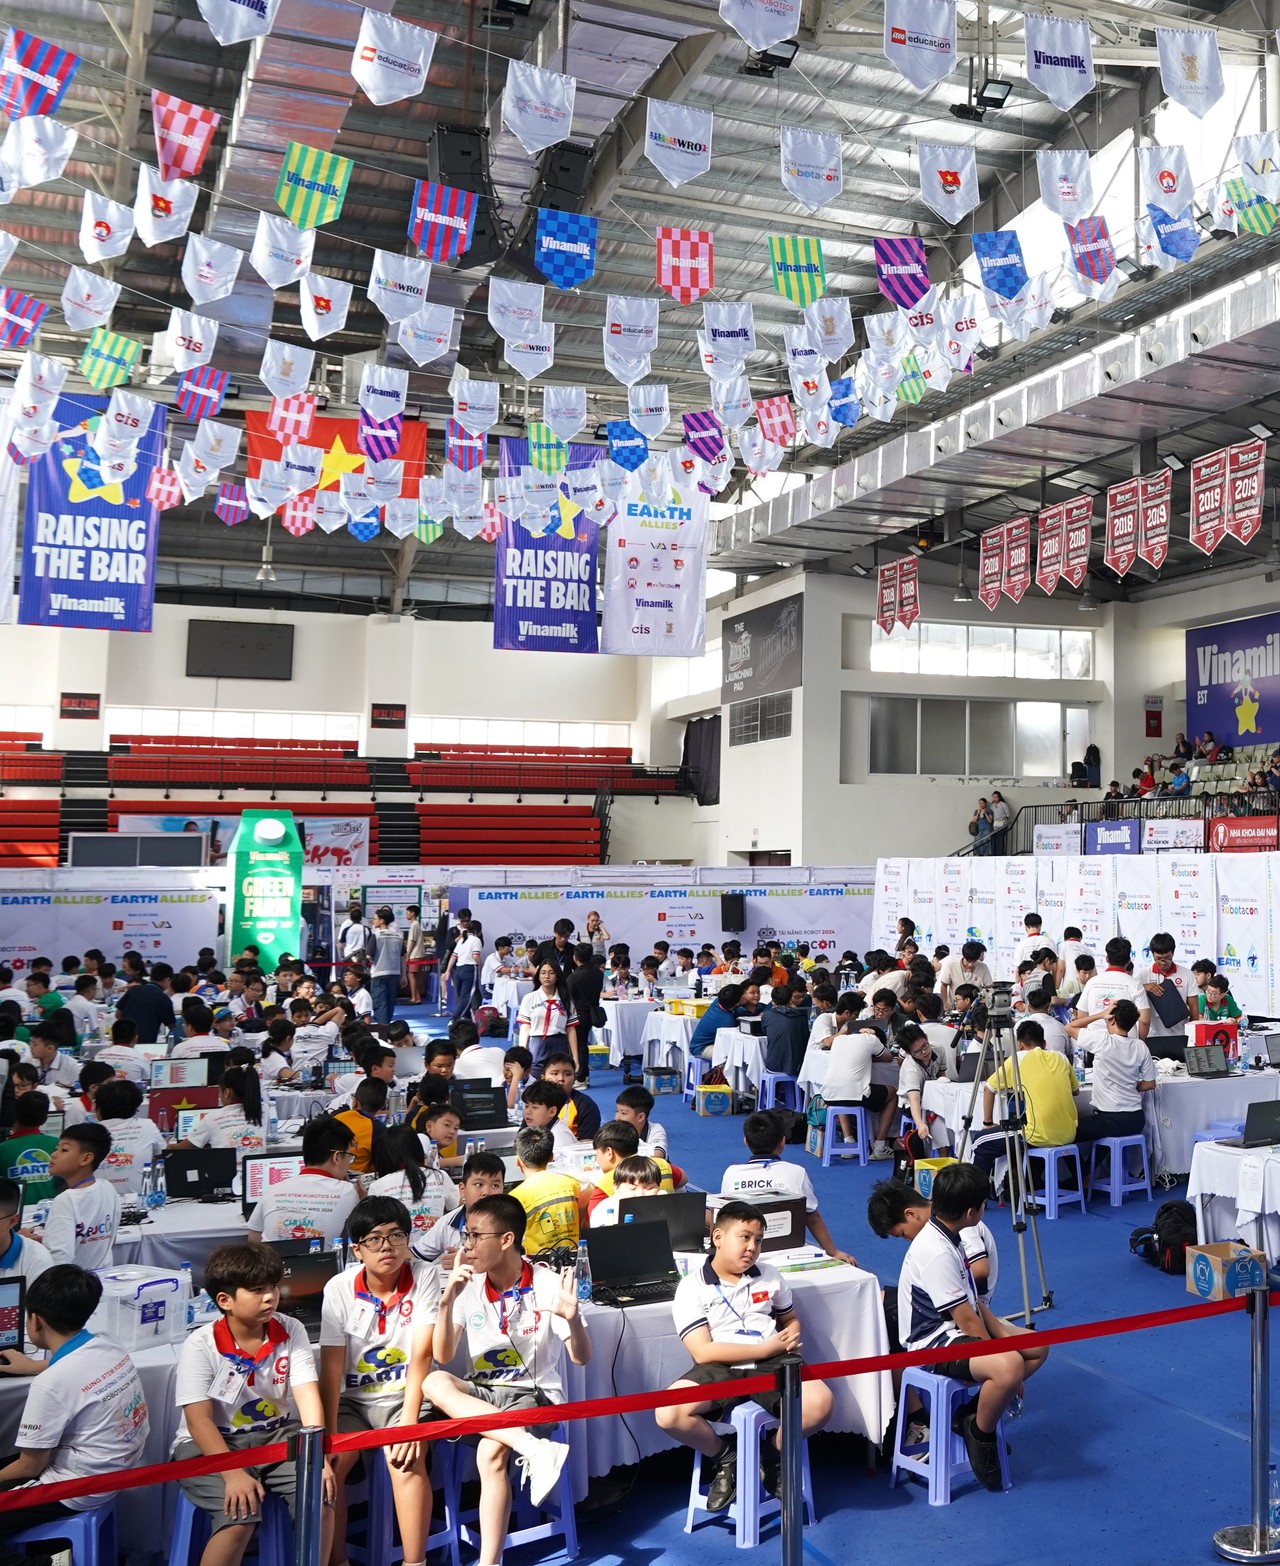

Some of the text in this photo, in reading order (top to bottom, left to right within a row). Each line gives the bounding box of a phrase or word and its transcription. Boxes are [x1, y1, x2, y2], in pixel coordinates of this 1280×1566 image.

[908, 34, 950, 49] education
[377, 53, 421, 75] education
[1034, 50, 1085, 69] Vinamilk
[677, 140, 701, 152] WRO
[784, 166, 839, 183] Robotacon
[286, 171, 340, 197] Vinamilk
[416, 207, 467, 229] Vinamilk
[542, 237, 590, 255] Vinamilk
[776, 261, 820, 274] Vinamilk
[622, 327, 653, 335] education
[712, 329, 749, 339] Vinamilk
[1235, 475, 1258, 500] 2019
[1199, 488, 1221, 512] 2019
[37, 512, 146, 551] RAISING
[640, 519, 678, 530] ALLIES
[1114, 514, 1133, 536] 2018
[32, 546, 146, 584] THE BAR
[506, 549, 590, 580] RAISING
[50, 593, 125, 614] Vinamilk
[503, 579, 590, 612] THE BAR
[636, 598, 673, 609] Vinamilk
[519, 621, 578, 638] Vinamilk
[734, 622, 745, 633] THE
[725, 668, 753, 683] LAUNCHING
[733, 681, 744, 692] PAD
[1197, 689, 1208, 705] EST
[1097, 826, 1130, 843] Vinamilk
[242, 877, 294, 897] GREEN
[478, 892, 518, 900] EARTH
[519, 891, 559, 899] ALLIES
[566, 891, 604, 899] EARTH
[650, 890, 686, 898] EARTH
[688, 889, 724, 897] ALLIES
[809, 888, 844, 896] EARTH
[53, 896, 100, 904] ALLIES
[111, 895, 158, 904] EARTH
[160, 895, 206, 903] ALLIES
[1118, 901, 1151, 910] Robotacon
[9, 1165, 49, 1178] EART
[741, 1180, 773, 1189] BRICK
[1200, 1262, 1210, 1280] ICY
[1235, 1259, 1252, 1272] ICY
[82, 1369, 115, 1392] HUNG STEM
[346, 1364, 407, 1388] EART
